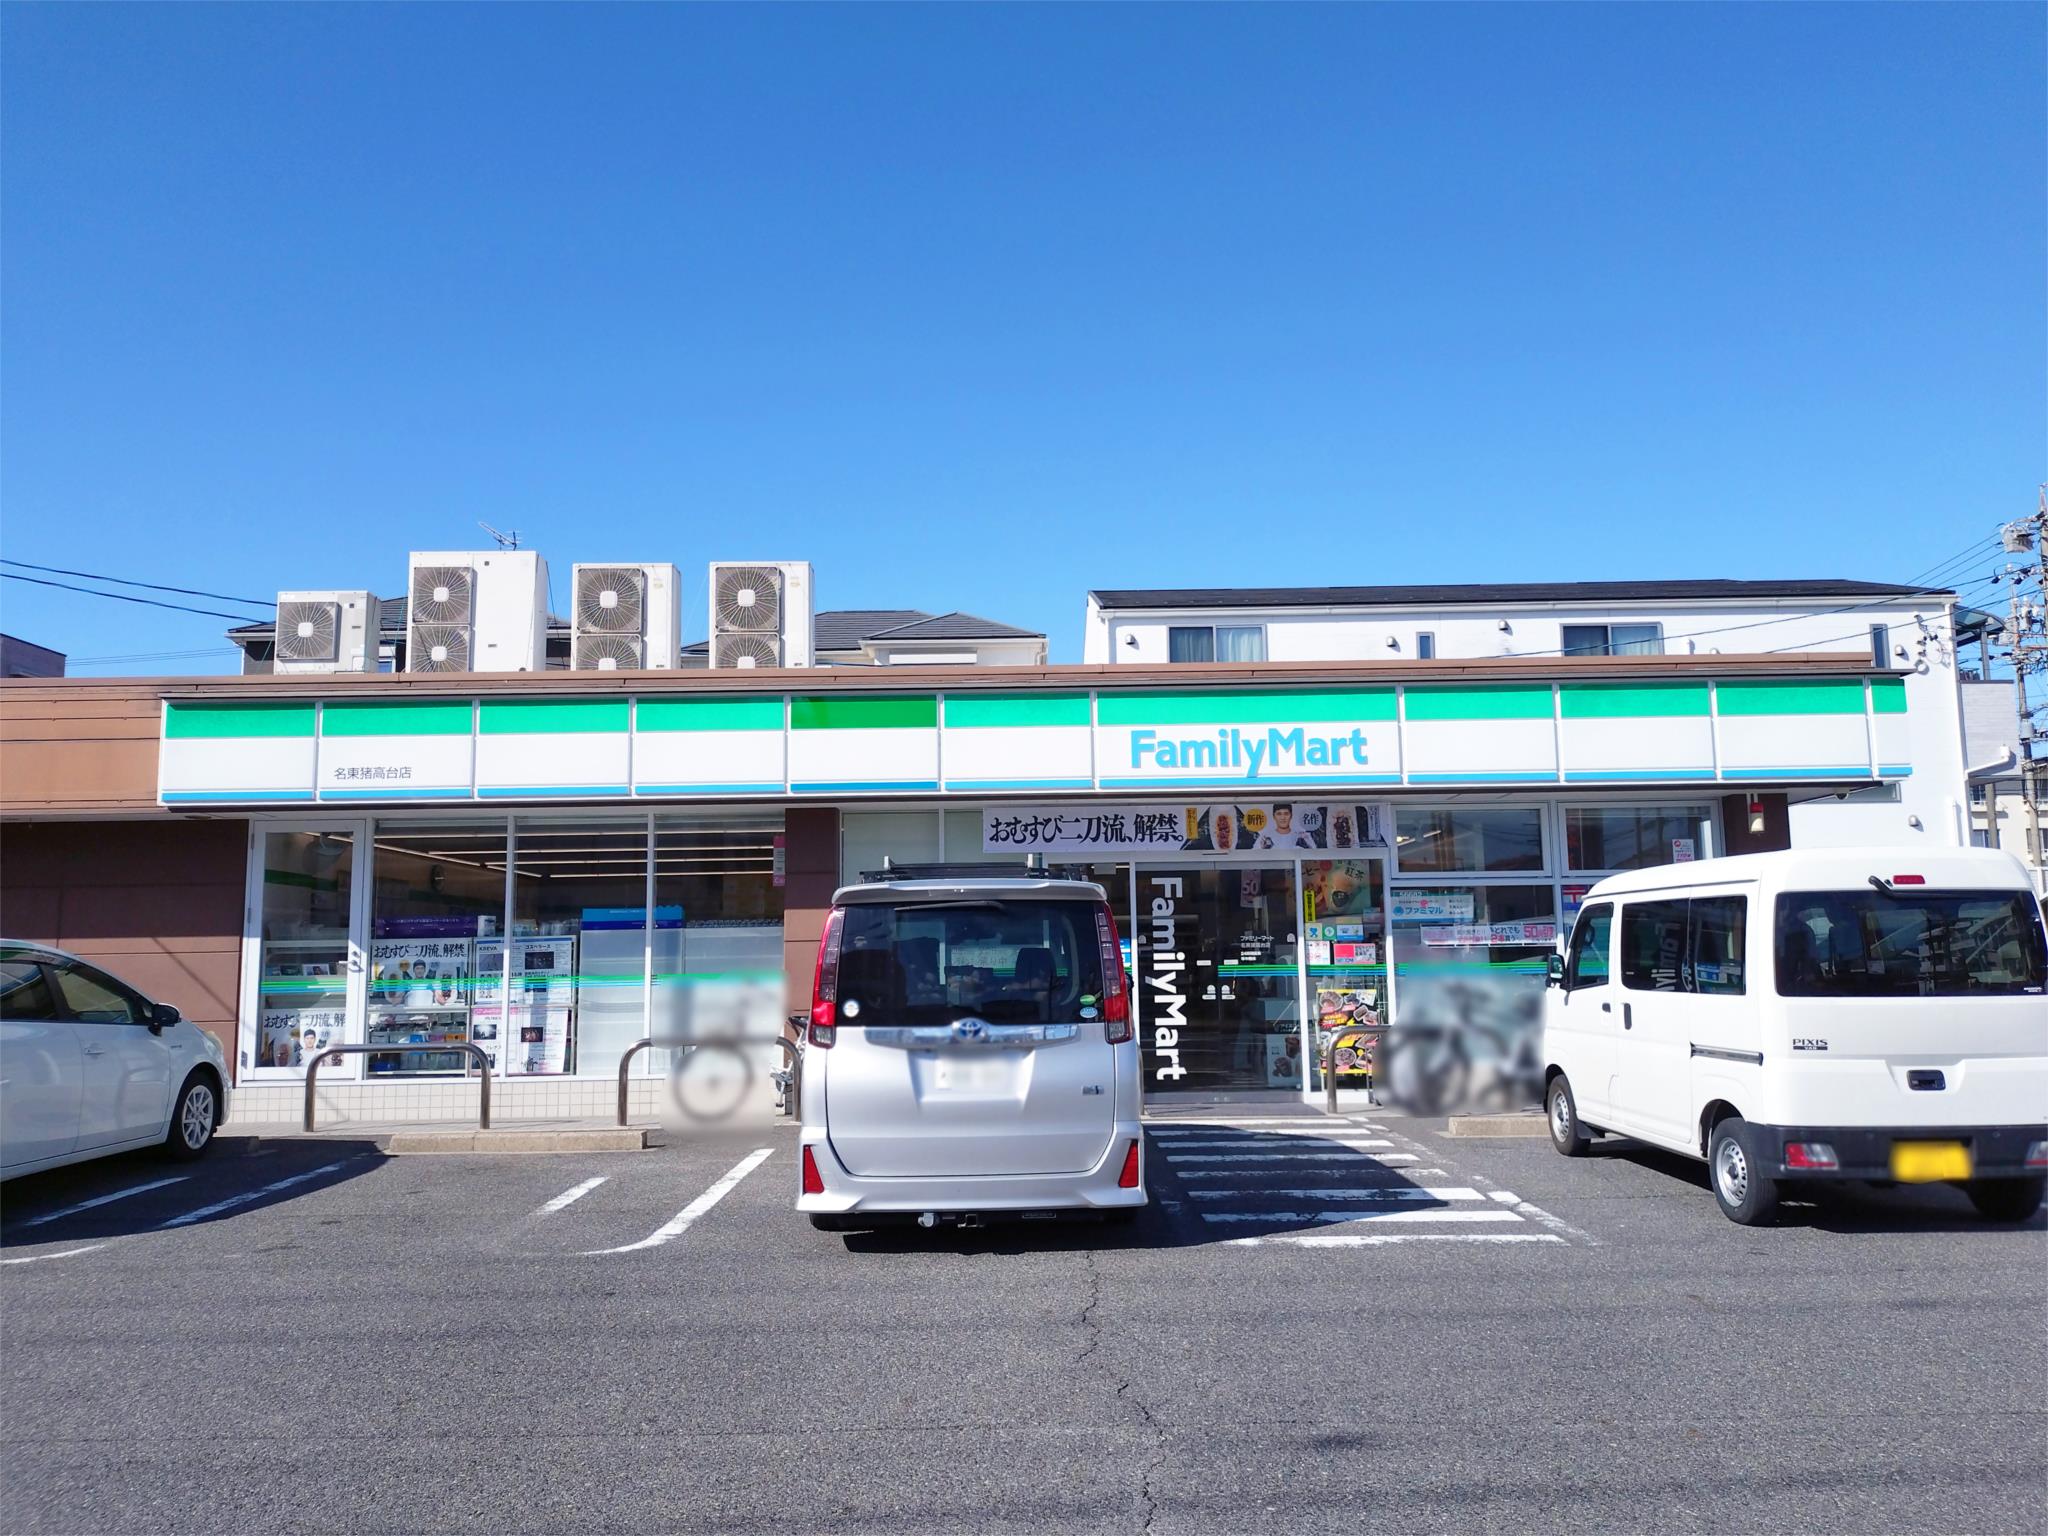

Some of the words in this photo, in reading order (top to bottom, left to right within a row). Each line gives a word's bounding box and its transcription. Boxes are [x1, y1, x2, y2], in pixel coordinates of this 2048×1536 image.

[1130, 727, 1369, 779] FamilyMart
[334, 766, 412, 780] 名東猪高台店
[1247, 813, 1265, 826] 新作
[1303, 813, 1320, 826] 名作
[989, 813, 1184, 845] おむすび二刀流、解禁。
[1145, 877, 1188, 1081] FamilyMart
[1792, 1038, 1828, 1046] PIXIS
